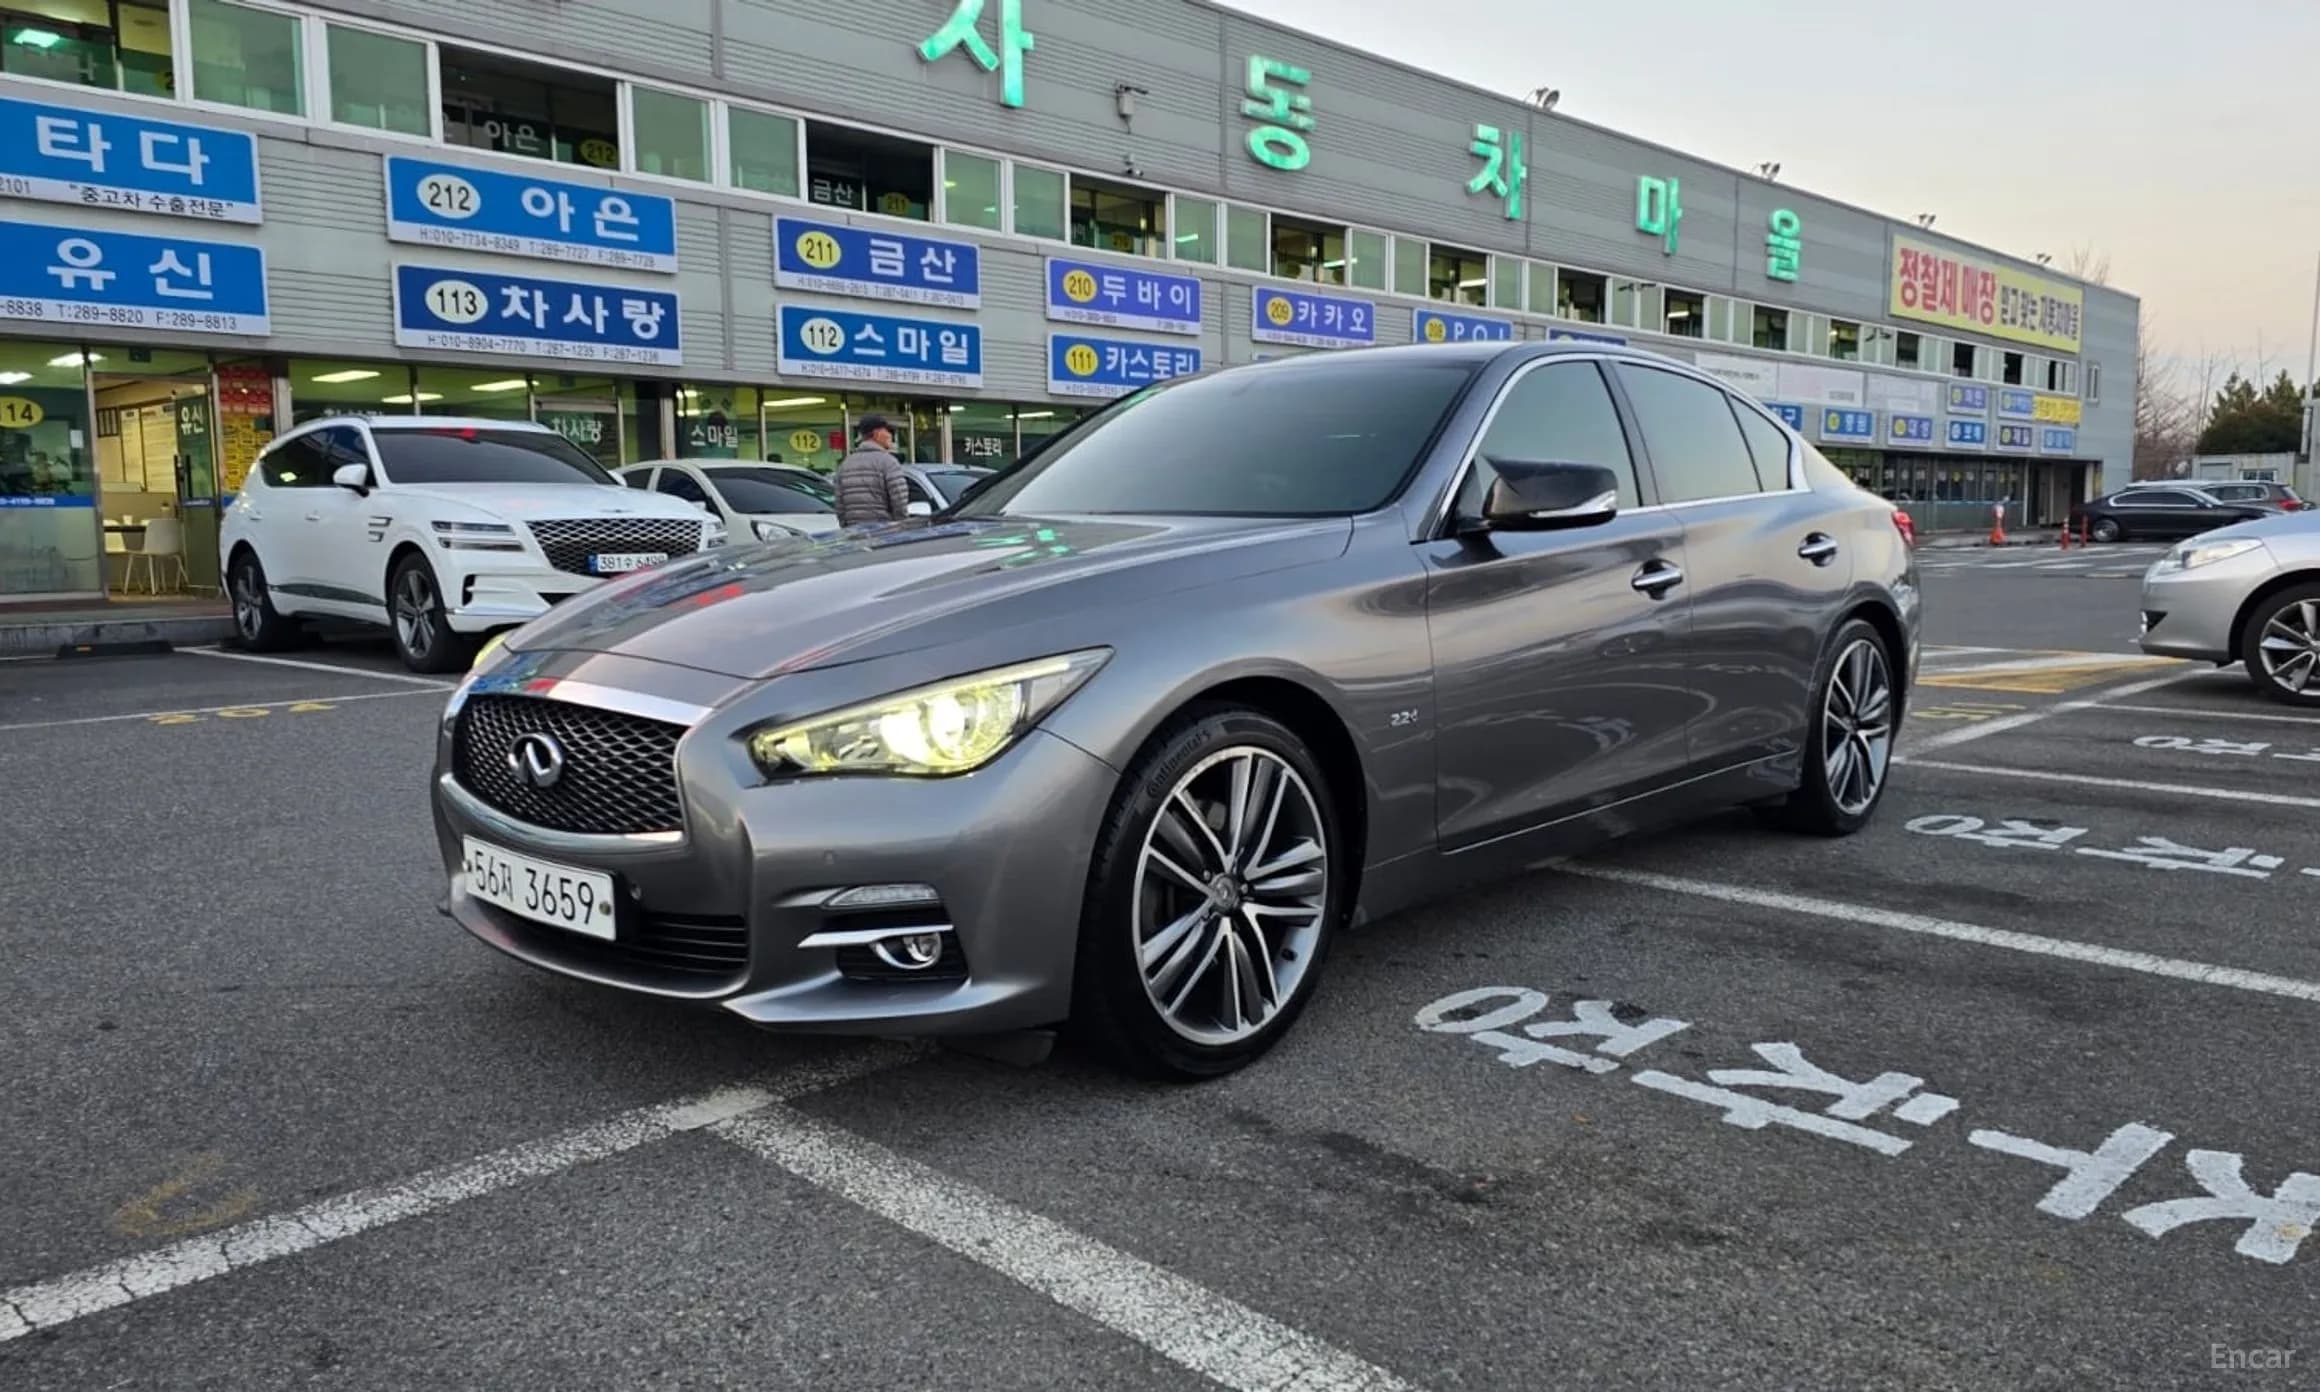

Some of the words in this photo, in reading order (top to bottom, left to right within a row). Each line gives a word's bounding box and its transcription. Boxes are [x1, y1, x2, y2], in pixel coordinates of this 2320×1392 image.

[814, 178, 854, 206] 금산
[428, 182, 472, 212] 212
[521, 186, 639, 242] 아은
[47, 238, 213, 300] 유신
[805, 238, 834, 257] 211
[869, 238, 956, 283] 금산
[436, 288, 478, 315] 113
[500, 285, 665, 340] 차사랑
[1068, 275, 1092, 298] 210
[1103, 275, 1191, 315] 두바이
[57, 304, 143, 323] T:289-8820
[156, 314, 237, 331] F:289-8813
[1298, 305, 1367, 333] 카카오
[808, 327, 837, 348] 112
[853, 323, 969, 365] 스마일
[1071, 348, 1093, 371] 111
[1106, 346, 1194, 378] 카스토리
[181, 407, 203, 436] 유신
[690, 424, 738, 449] 스마일
[795, 433, 817, 450] 112
[525, 868, 594, 924] 3659
